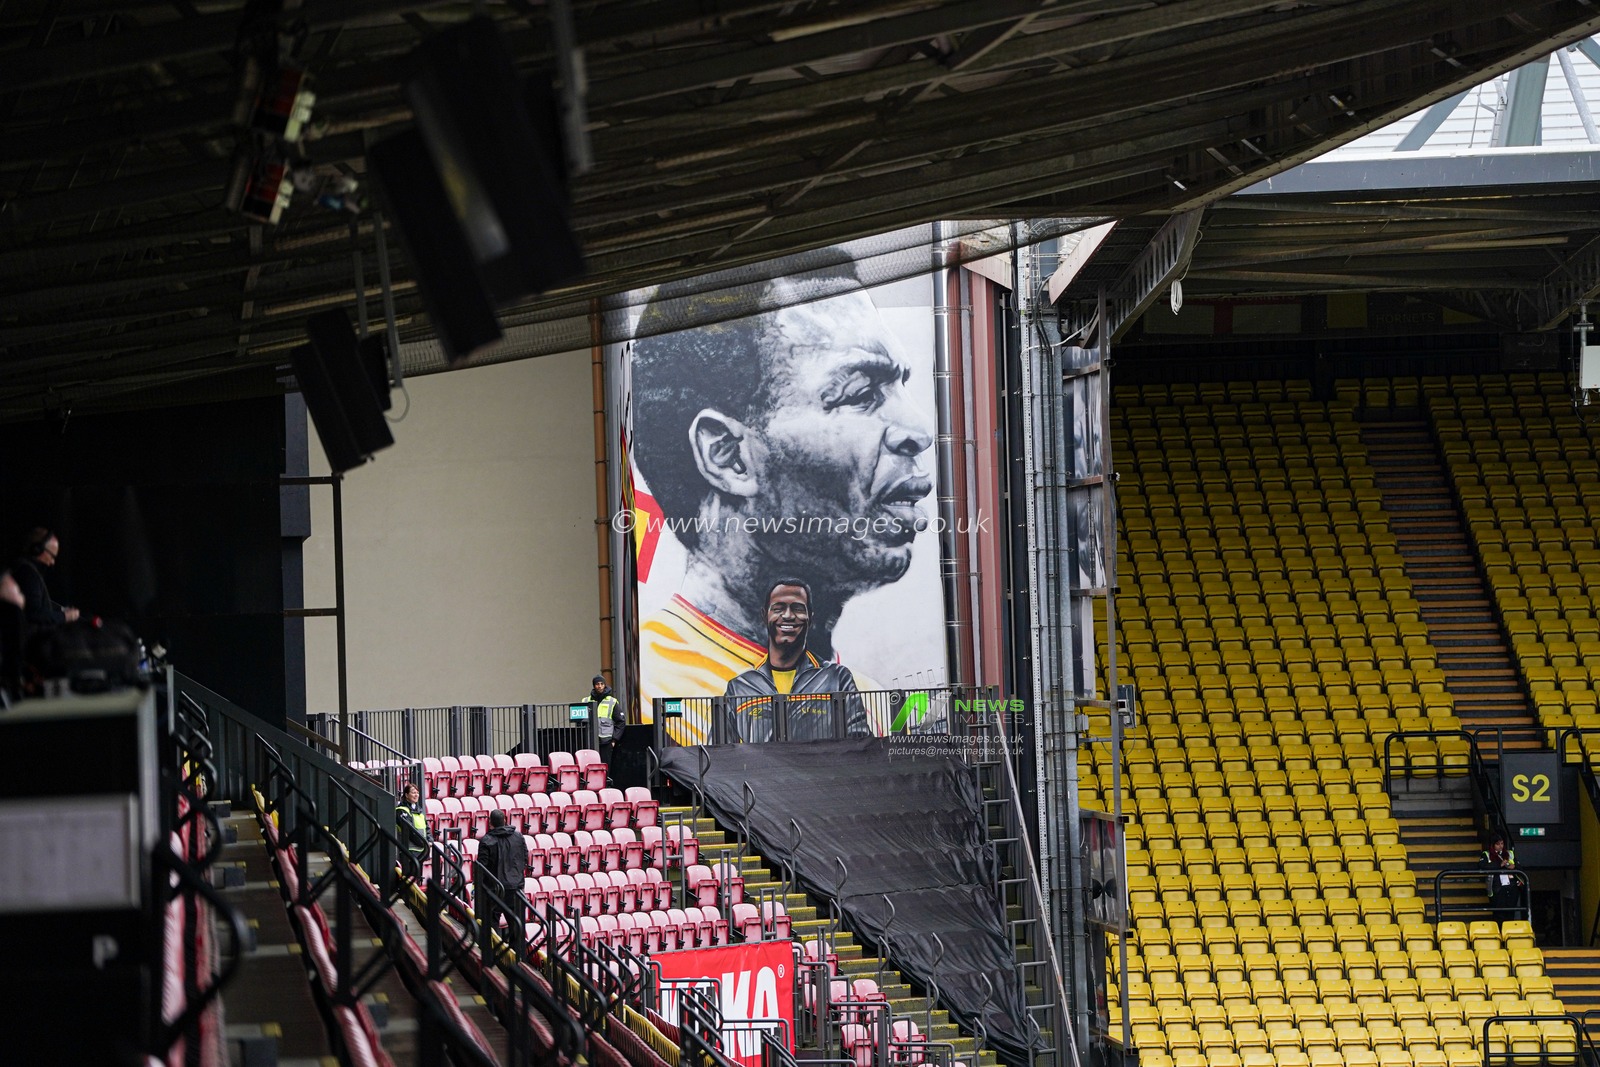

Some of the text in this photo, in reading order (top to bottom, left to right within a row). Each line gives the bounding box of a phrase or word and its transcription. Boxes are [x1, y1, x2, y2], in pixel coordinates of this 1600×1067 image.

[667, 703, 680, 711] EXIT
[572, 709, 586, 718] EXIT
[1512, 774, 1551, 802] S2
